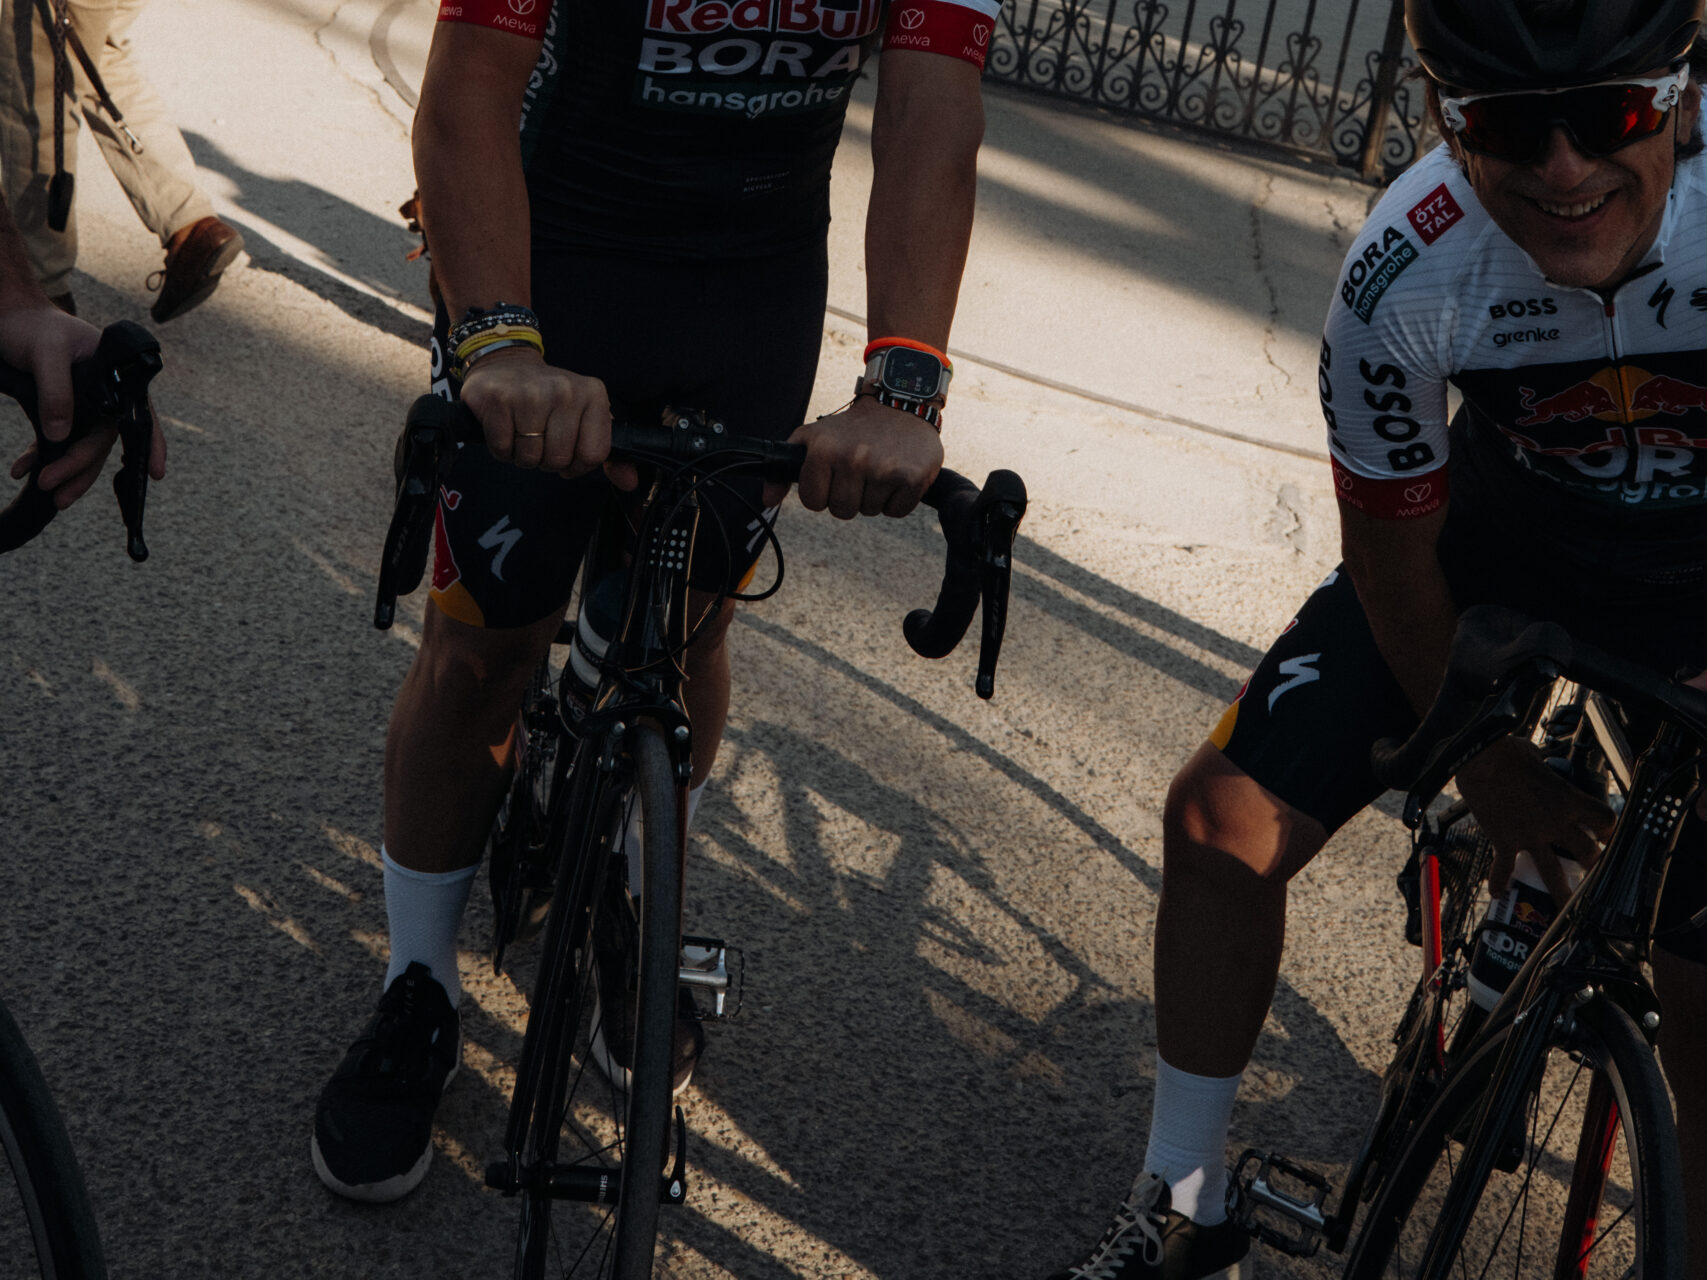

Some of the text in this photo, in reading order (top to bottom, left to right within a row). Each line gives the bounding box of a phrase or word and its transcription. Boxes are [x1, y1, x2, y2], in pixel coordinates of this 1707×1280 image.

[637, 37, 861, 78] BORA
[642, 76, 846, 120] hansgrohe
[1415, 194, 1447, 224] ÖTZ
[1422, 210, 1455, 234] TAL
[1341, 226, 1404, 308] BORA
[1354, 247, 1413, 319] hansgrohe
[1489, 297, 1558, 319] BOSS
[1493, 327, 1560, 348] grenke
[1359, 358, 1435, 471] BOSS
